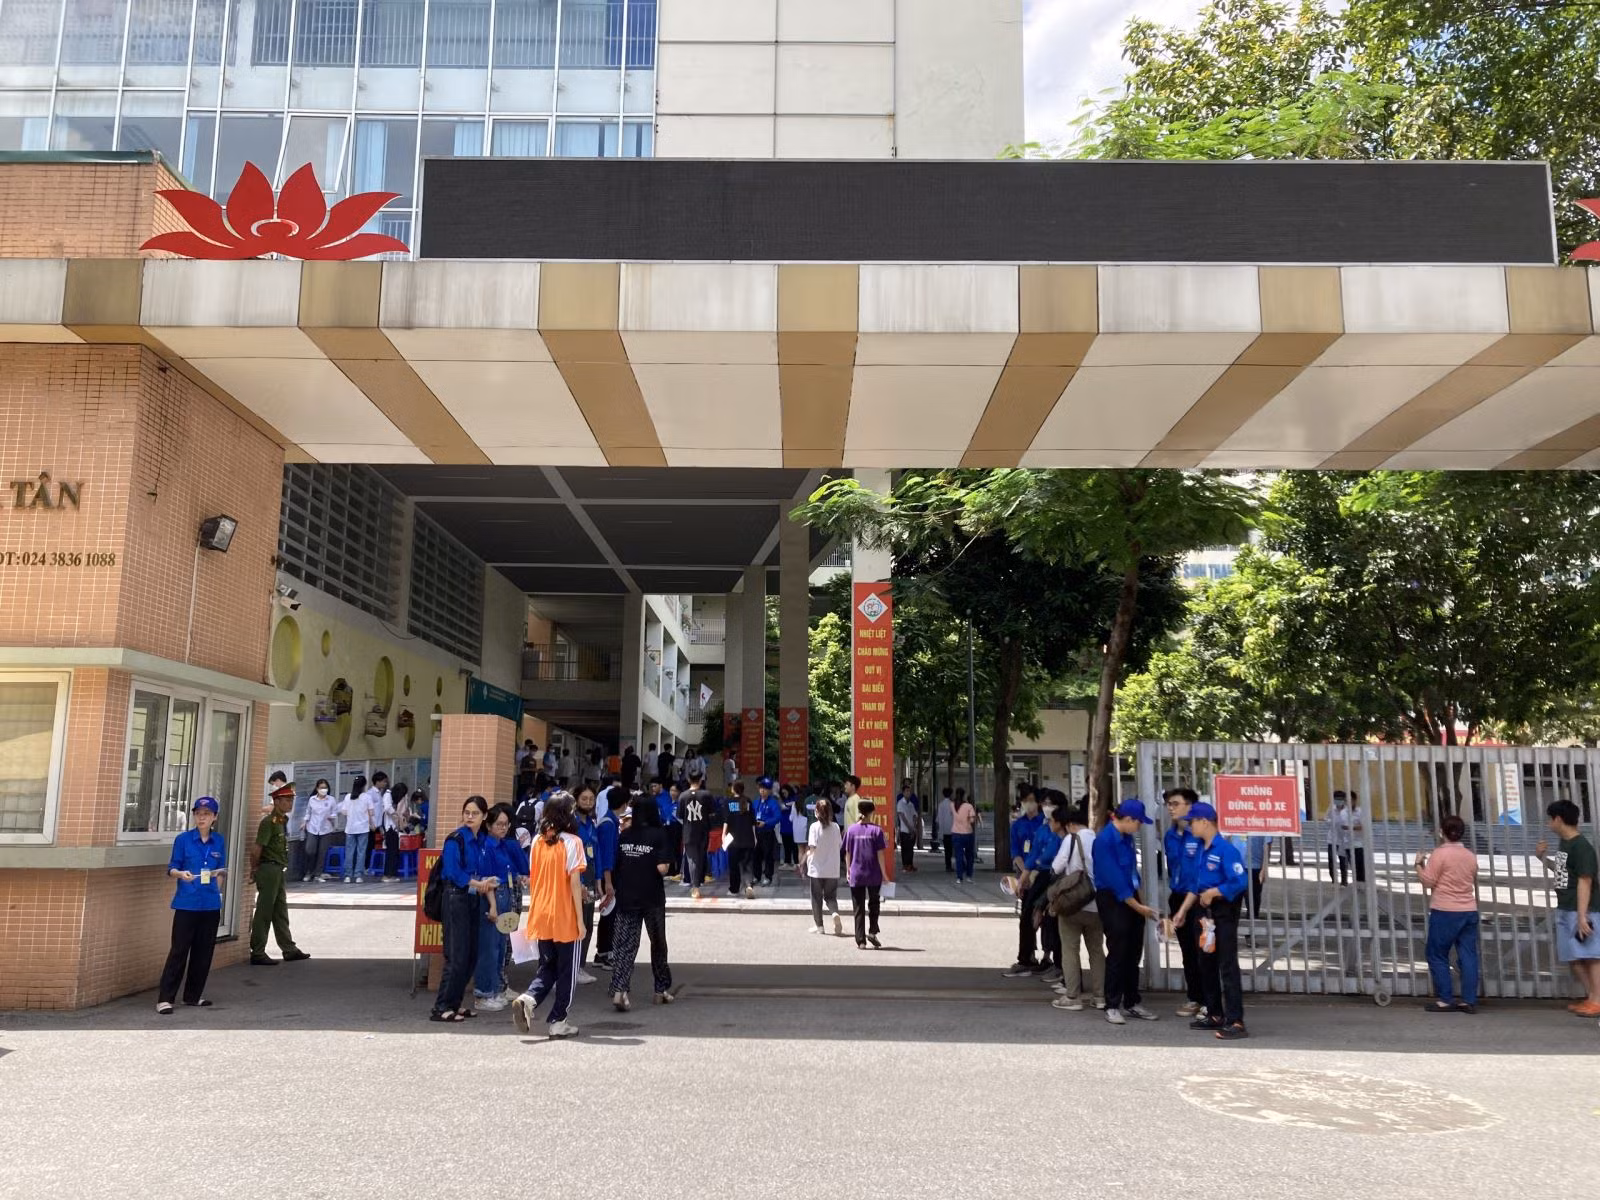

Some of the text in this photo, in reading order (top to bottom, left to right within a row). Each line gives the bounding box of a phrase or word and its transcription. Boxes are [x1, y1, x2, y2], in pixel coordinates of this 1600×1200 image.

[10, 471, 84, 511] TÂN
[50, 552, 82, 567] 3836
[85, 552, 116, 567] 1088
[1240, 785, 1273, 796] KHÔNG
[1274, 802, 1286, 812] XE
